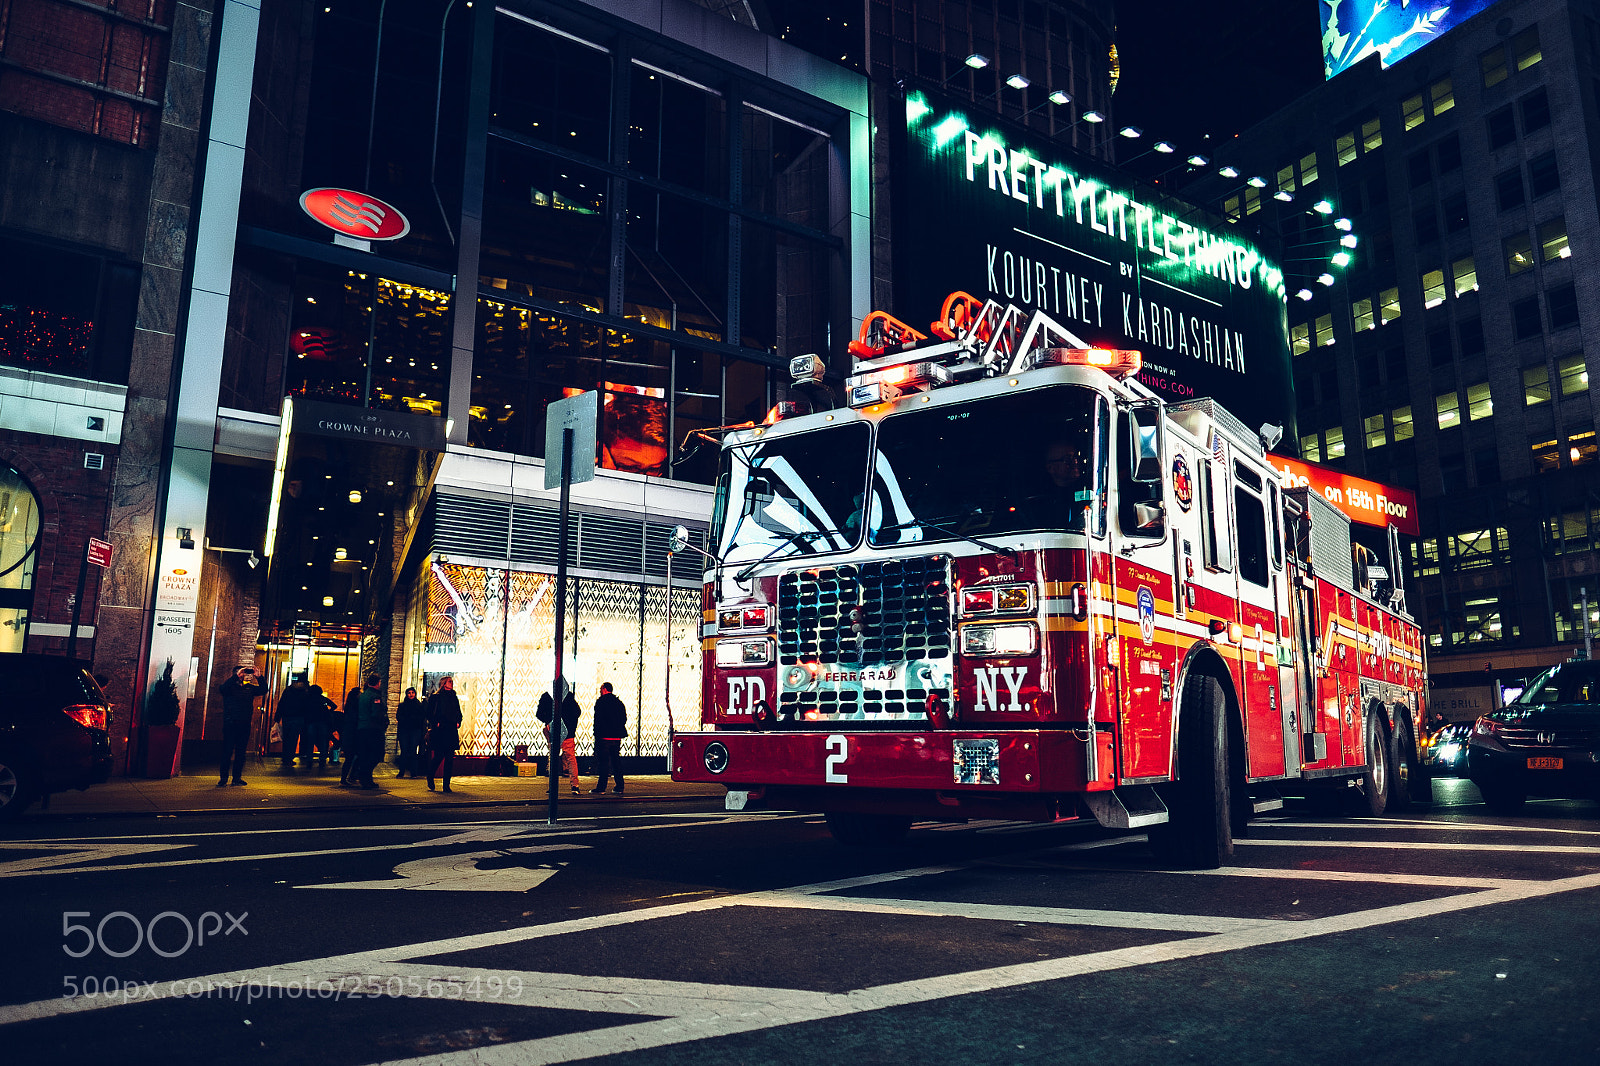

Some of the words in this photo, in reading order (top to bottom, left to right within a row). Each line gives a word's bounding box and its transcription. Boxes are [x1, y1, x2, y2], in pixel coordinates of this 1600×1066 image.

[964, 129, 1251, 290] PRETTYLITTLETHING
[1119, 260, 1133, 279] BY
[986, 243, 1103, 328] KOURTNEY
[1121, 291, 1246, 375] KARDASHIAN
[1153, 364, 1168, 375] NOW
[1169, 369, 1176, 377] AT
[1136, 371, 1194, 398] THING.COM
[318, 420, 368, 435] CROWNE
[374, 427, 411, 440] PLAZA
[1324, 485, 1343, 503] on
[1345, 486, 1375, 511] 15th
[1375, 493, 1409, 519] Floor
[161, 575, 197, 585] CROWNE
[165, 582, 191, 590] PLAZA
[157, 615, 192, 624] BRASSERIE
[164, 627, 182, 635] 1605
[1254, 622, 1266, 672] 2
[825, 670, 886, 683] FERRARA
[973, 666, 1031, 712] N.Y.
[1450, 698, 1480, 709] BRILL
[825, 734, 848, 784] 2
